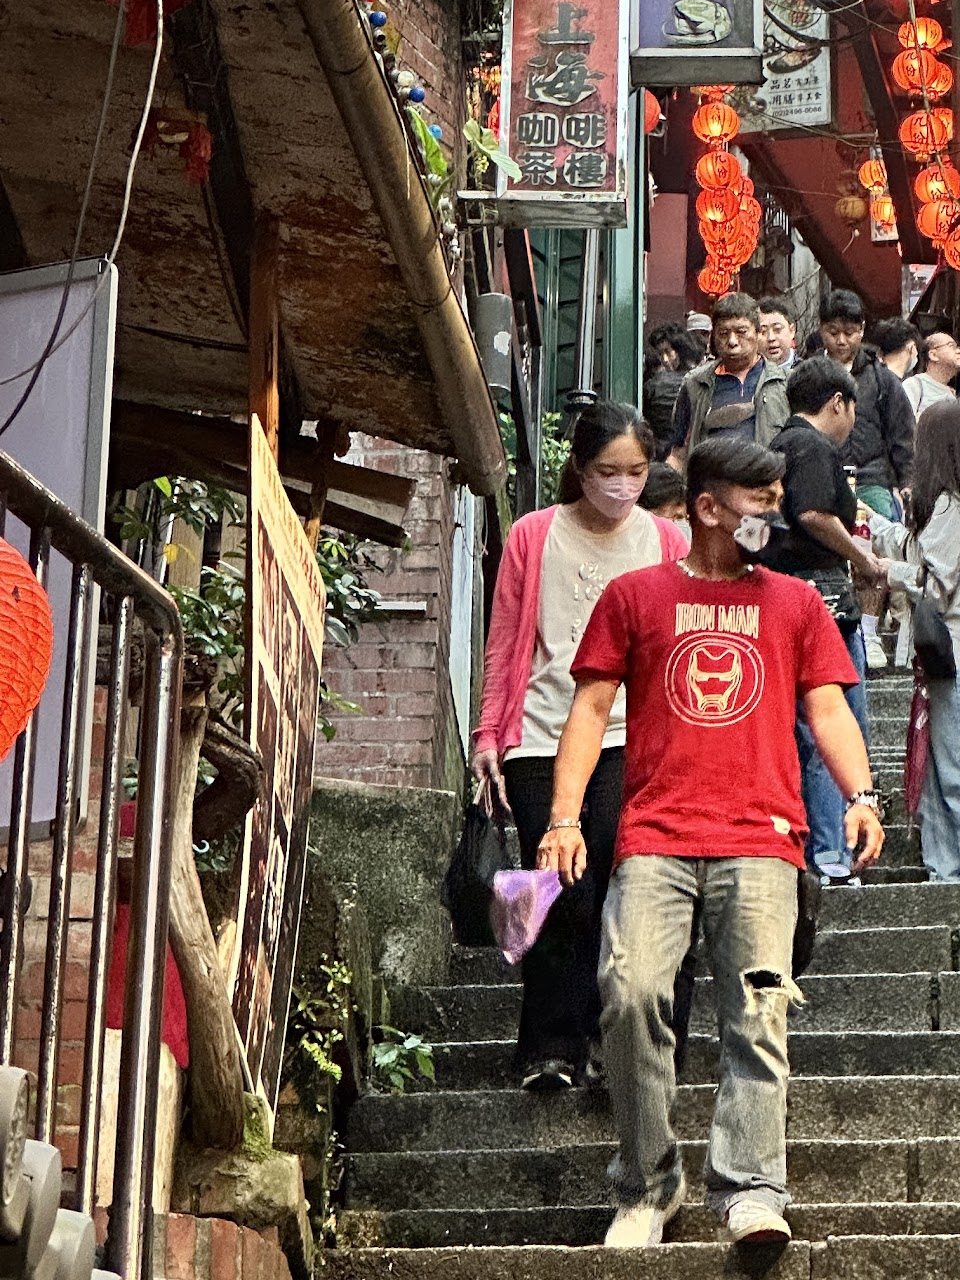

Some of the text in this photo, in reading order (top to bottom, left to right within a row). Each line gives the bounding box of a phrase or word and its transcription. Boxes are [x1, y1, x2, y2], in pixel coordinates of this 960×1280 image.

[517, 112, 608, 149] 咖啡
[516, 151, 608, 188] 茶樓
[674, 601, 761, 640] IRON MAN
